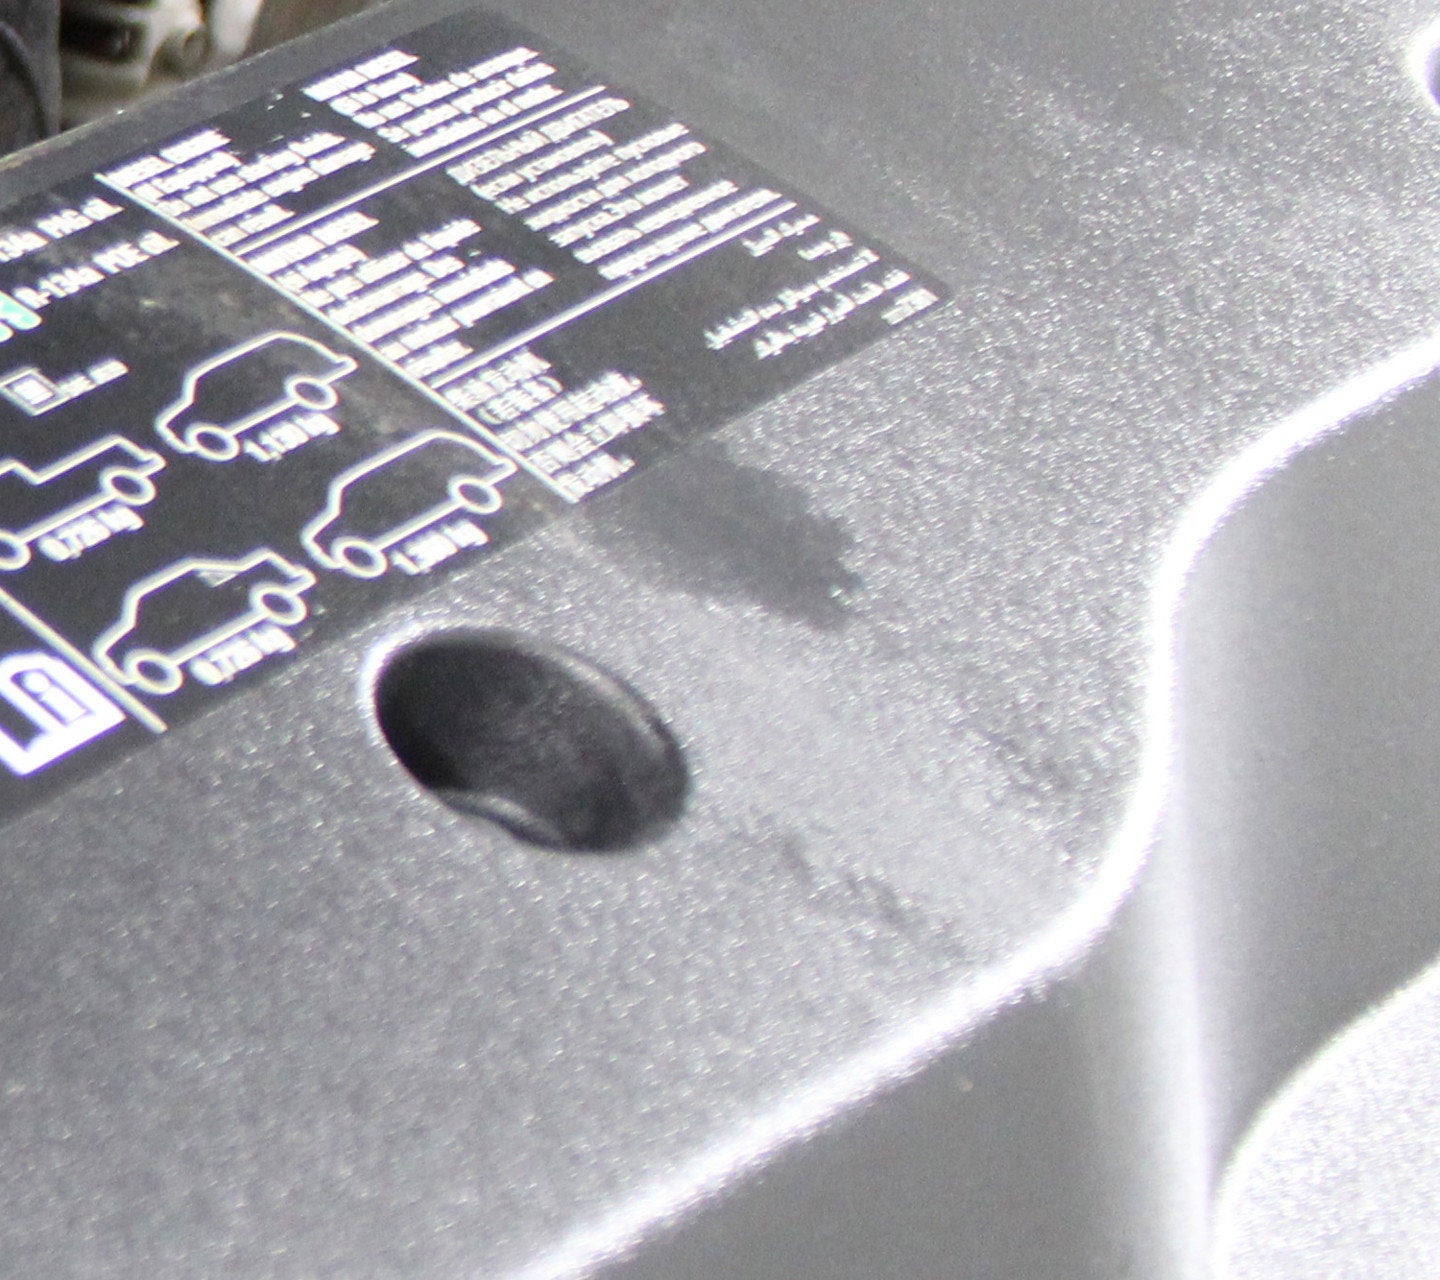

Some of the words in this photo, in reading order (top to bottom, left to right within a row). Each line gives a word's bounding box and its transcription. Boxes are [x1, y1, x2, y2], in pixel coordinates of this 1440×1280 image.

[12, 266, 106, 310] R-134a
[96, 504, 145, 532] kg
[248, 625, 298, 653] kg
